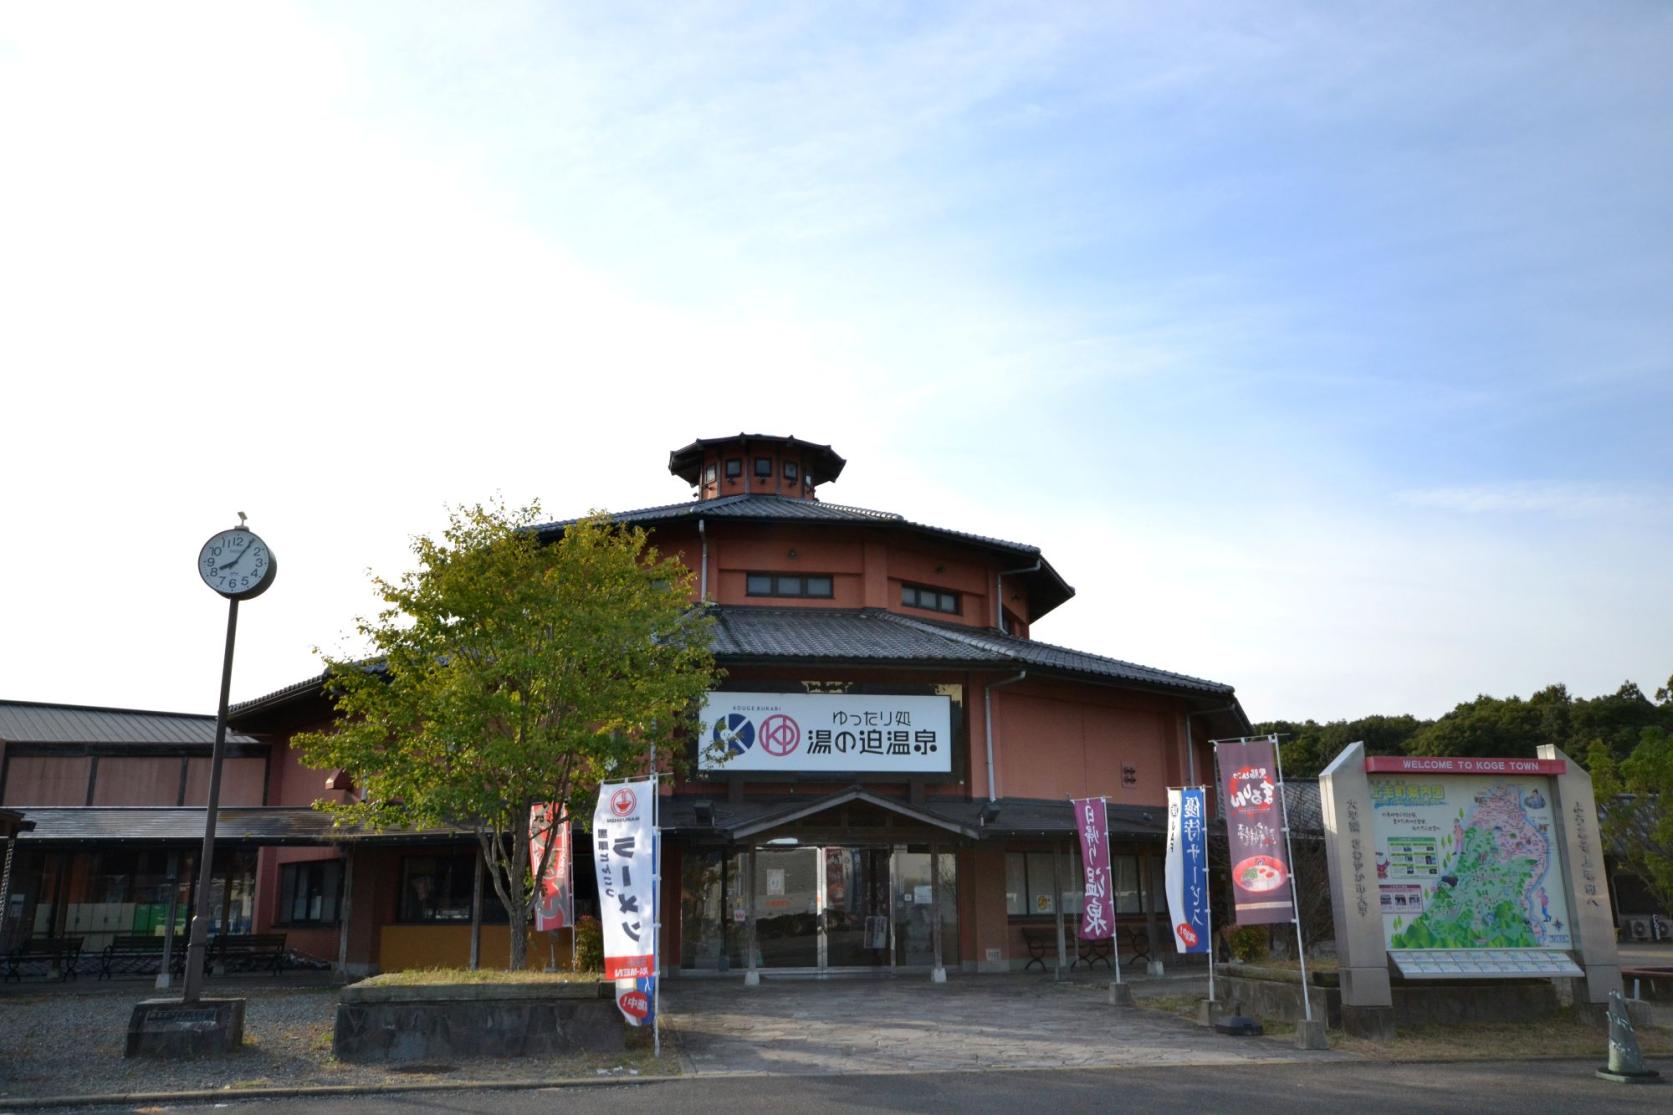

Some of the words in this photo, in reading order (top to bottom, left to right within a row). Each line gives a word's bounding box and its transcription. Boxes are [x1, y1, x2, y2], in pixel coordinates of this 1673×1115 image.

[222, 537, 230, 548] 11
[233, 537, 244, 546] 12
[210, 546, 222, 557] 10
[254, 548, 261, 557] 2
[208, 558, 215, 567] 9
[256, 558, 263, 568] 3
[210, 568, 218, 577] 8
[251, 569, 258, 578] 4
[218, 576, 226, 585] 7
[228, 579, 236, 588] 6
[241, 577, 249, 586] 5
[832, 710, 912, 727] ゆったり処
[806, 729, 938, 755] 湯の迫温泉
[1403, 760, 1453, 770] WELCOME
[1458, 760, 1472, 770] TO
[1476, 761, 1506, 770] KOGE
[1510, 762, 1539, 770] TOWN
